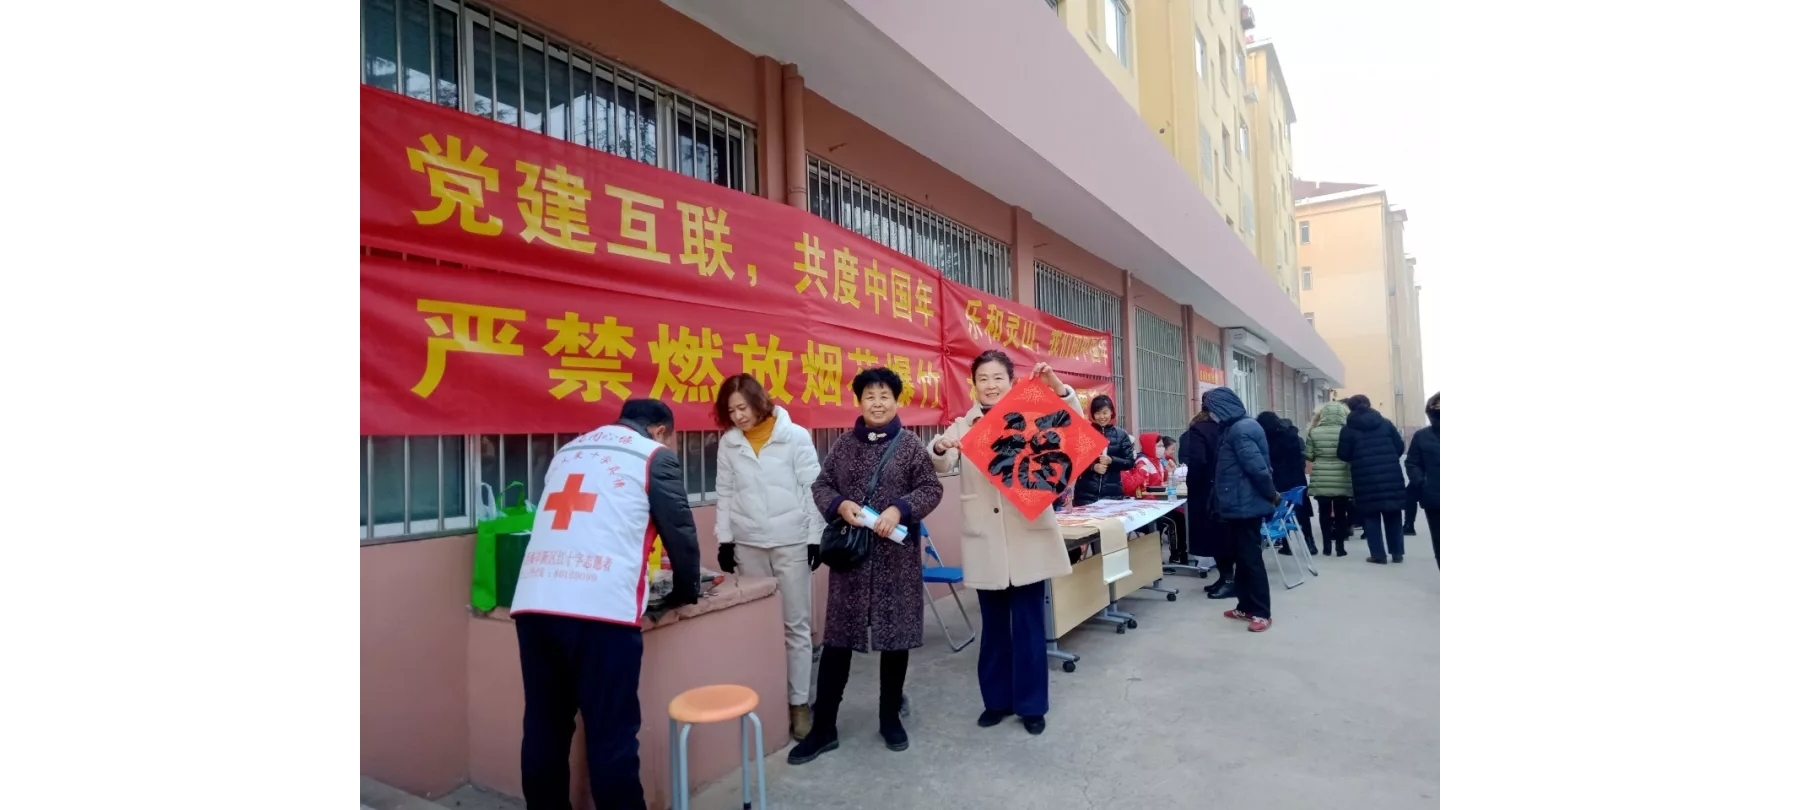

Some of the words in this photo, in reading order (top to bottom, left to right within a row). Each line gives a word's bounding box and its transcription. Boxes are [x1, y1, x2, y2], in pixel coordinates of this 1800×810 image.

[406, 132, 936, 328] 党建互联，共度中国年
[988, 410, 1073, 494] 福
